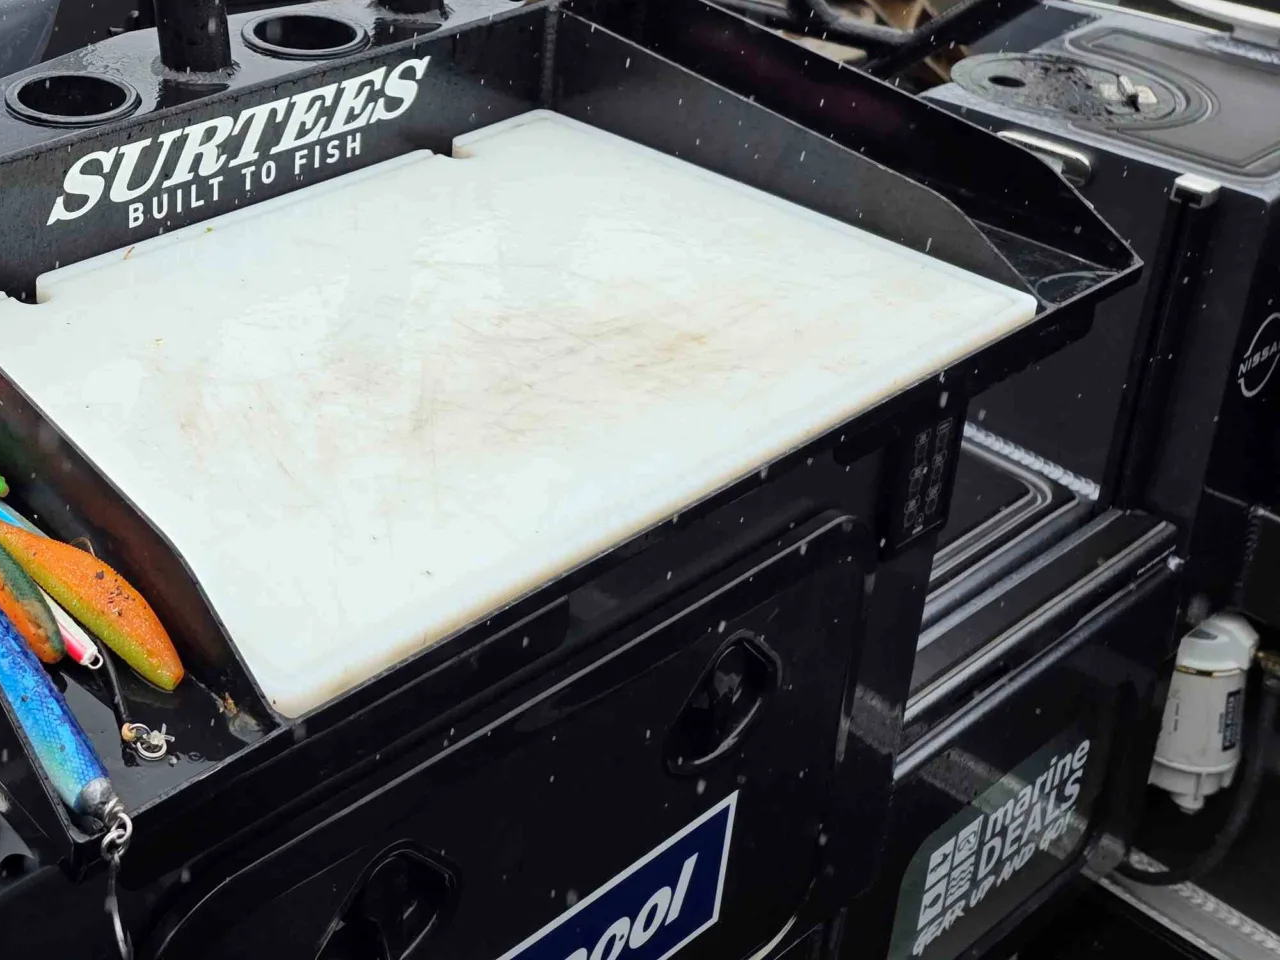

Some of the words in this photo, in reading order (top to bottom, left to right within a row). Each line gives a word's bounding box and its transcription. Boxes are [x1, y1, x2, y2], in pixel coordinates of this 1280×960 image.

[46, 56, 431, 226] SURTEES
[128, 177, 225, 229] BUILT
[242, 159, 277, 191] TO
[294, 132, 362, 175] FISH
[1237, 339, 1280, 378] NISSA
[976, 768, 1083, 882] DEALS
[984, 739, 1091, 843] marine
[564, 852, 699, 960] ool
[912, 899, 966, 957] GEAR
[969, 875, 995, 908] UP
[997, 842, 1036, 887] AND
